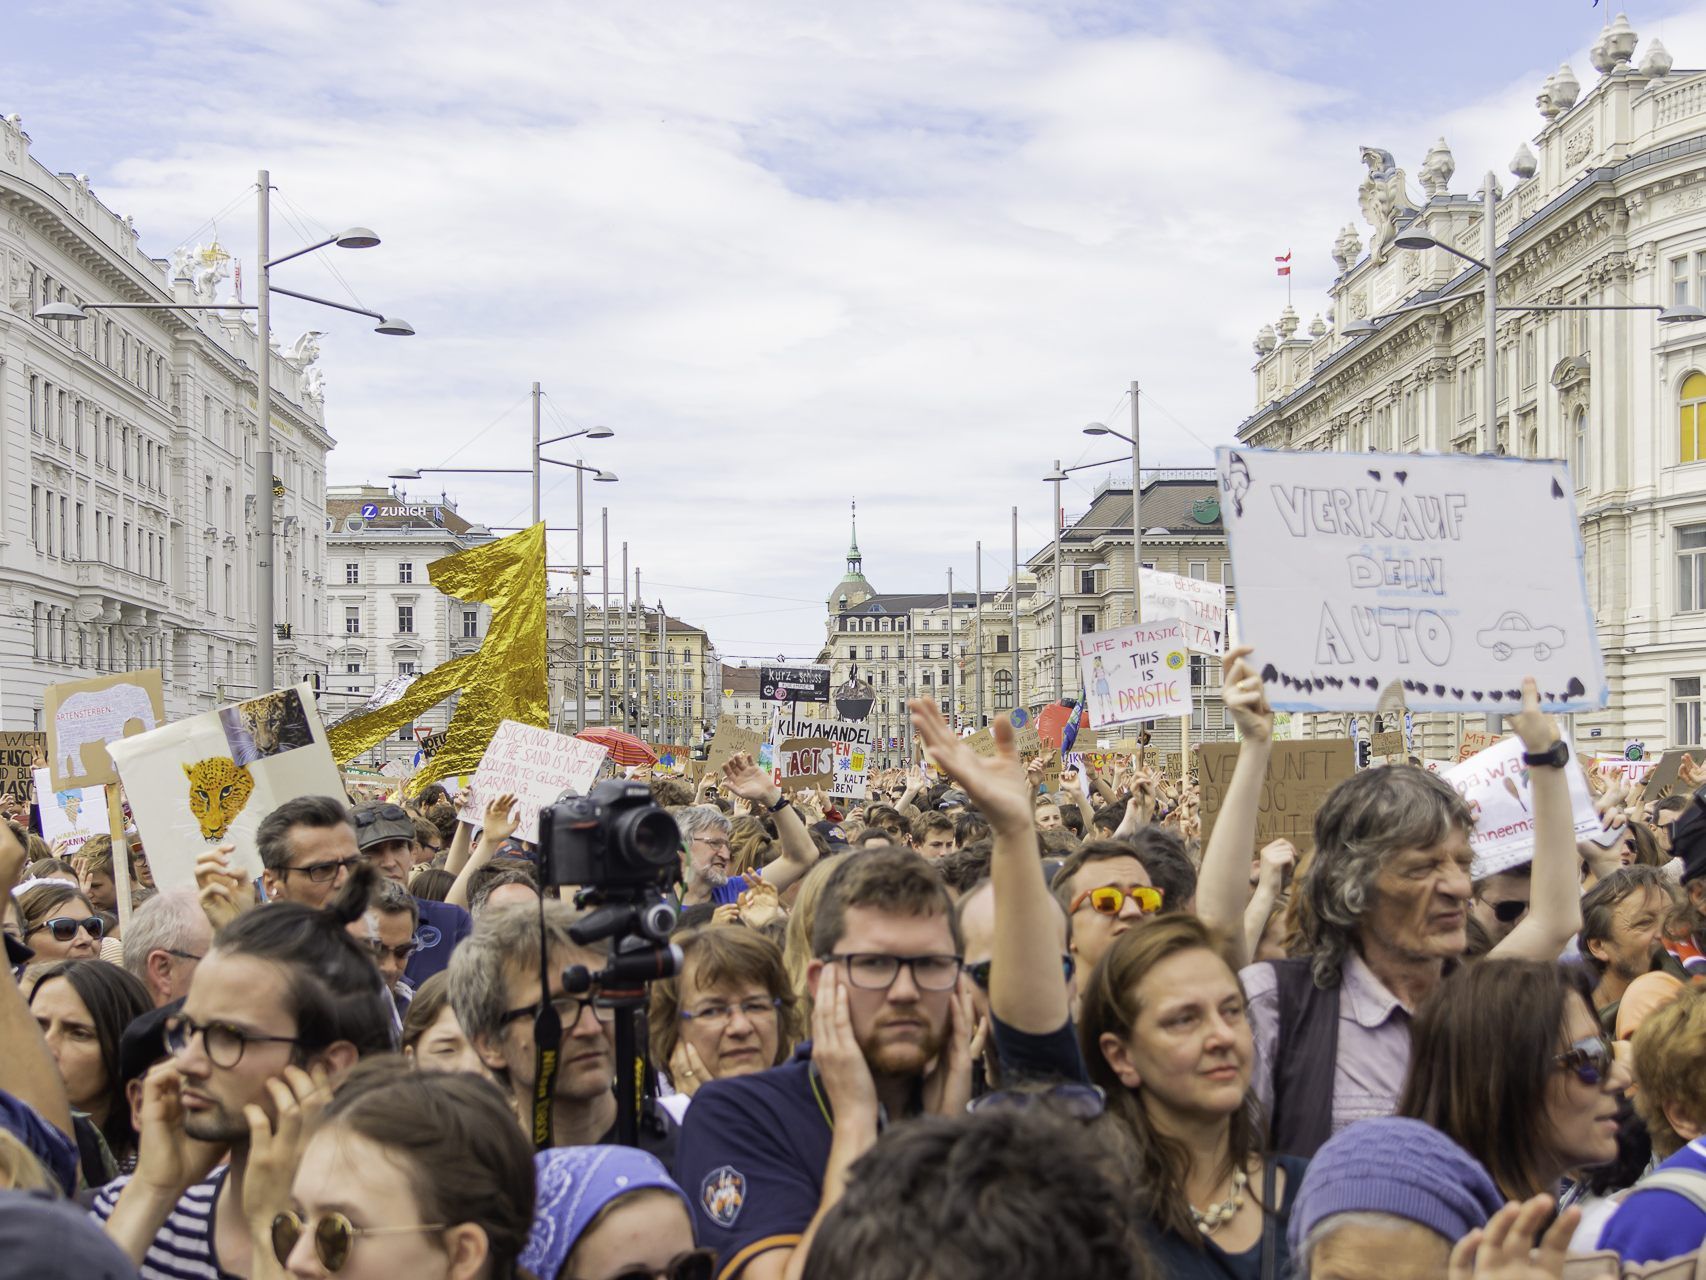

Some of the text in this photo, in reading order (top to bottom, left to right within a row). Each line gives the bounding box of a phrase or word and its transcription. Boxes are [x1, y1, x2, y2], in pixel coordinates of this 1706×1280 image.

[381, 506, 426, 516] ZURICH
[1271, 485, 1466, 541] VERKAUF
[1346, 555, 1444, 595] DEIN
[1192, 601, 1221, 621] THUN
[1080, 626, 1178, 656] LIFE IN PLASTIC
[1315, 602, 1453, 667] AUTO
[1129, 651, 1159, 669] THIS
[1142, 670, 1154, 681] IS
[1118, 681, 1180, 713] DRASTIC
[57, 707, 111, 721] ARTENSTERBEN
[497, 722, 549, 748] STICKING
[552, 735, 581, 757] YOUR
[777, 719, 872, 745] KLIMAWANDEL
[1465, 733, 1486, 745] Mit
[520, 748, 550, 766] SAND
[781, 748, 832, 777] FACTS
[844, 774, 865, 784] KALT
